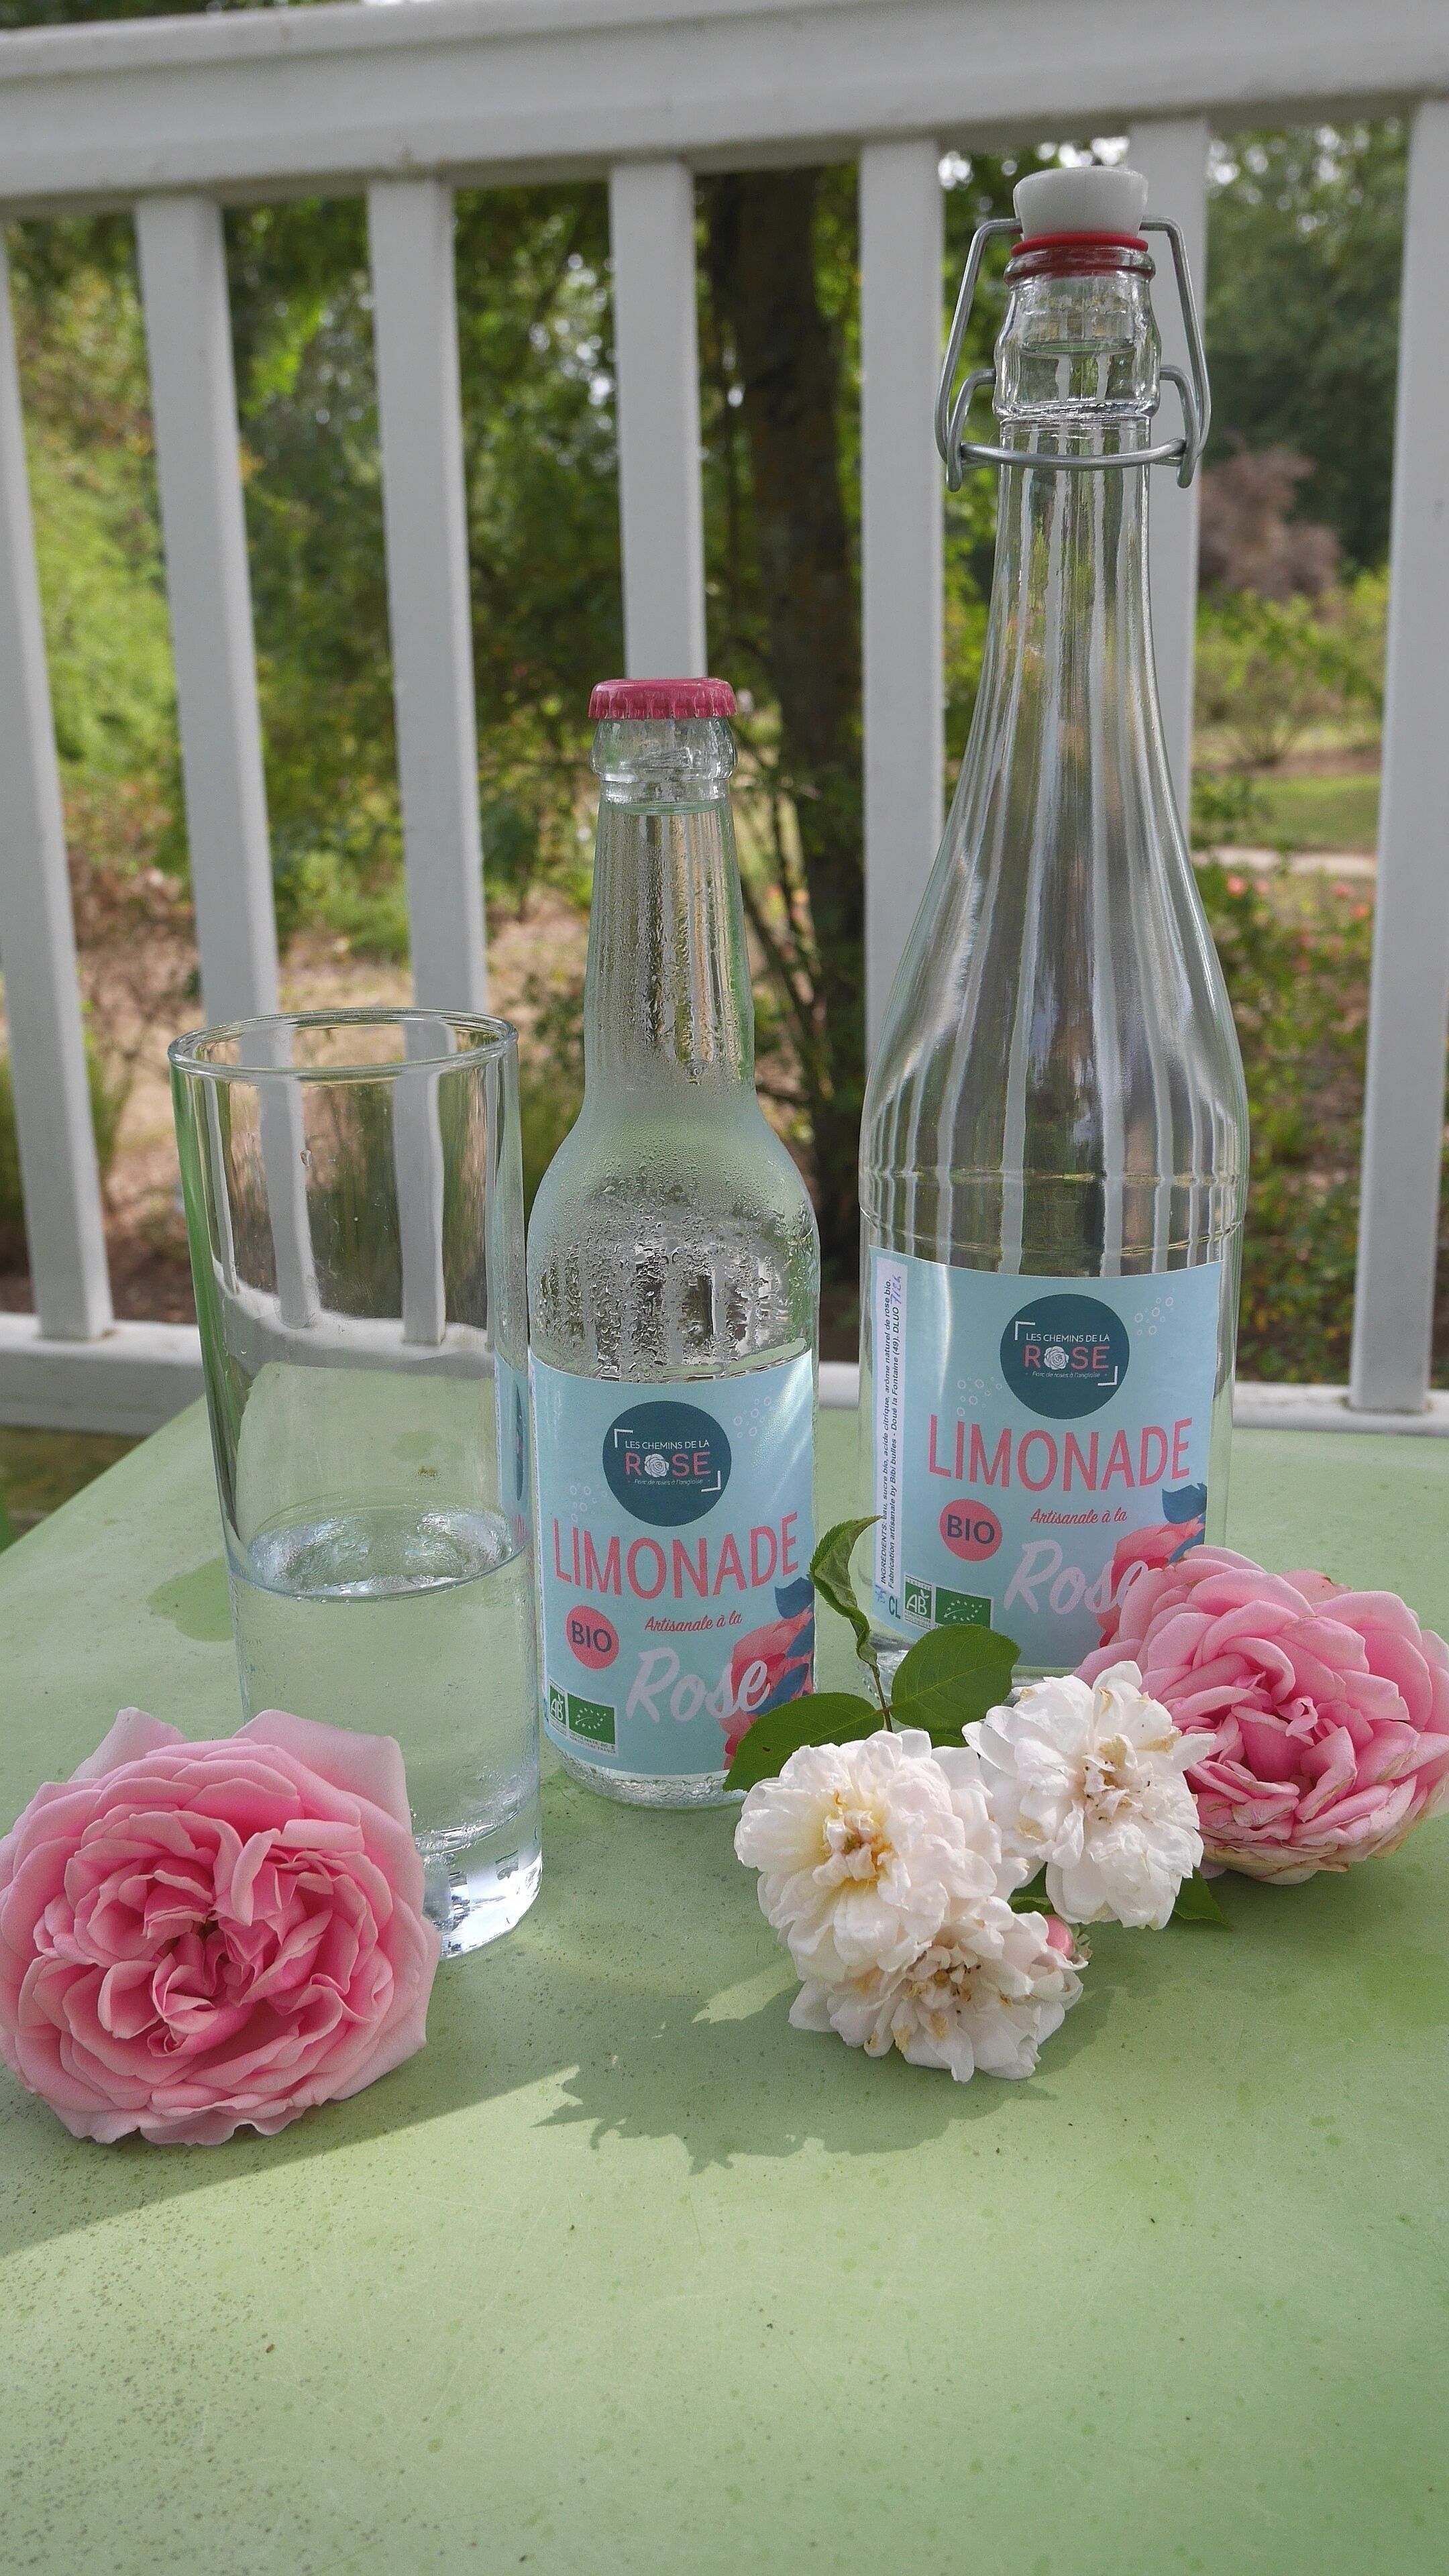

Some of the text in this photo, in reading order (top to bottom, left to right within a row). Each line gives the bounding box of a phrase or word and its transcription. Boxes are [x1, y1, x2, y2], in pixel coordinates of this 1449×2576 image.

[884, 1319, 890, 1330] de
[892, 1336, 900, 1355] (49).
[1026, 1333, 1110, 1342] LES CHEMINS DE LA
[892, 1397, 898, 1406] la
[625, 1439, 710, 1450] LES CHEMINS DE LA
[928, 1414, 1193, 1493] LIMONADE
[890, 1485, 897, 1497] by
[888, 1498, 896, 1540] artisanale
[1030, 1507, 1128, 1525] Artisanale à la
[947, 1513, 996, 1544] BIO
[552, 1511, 799, 1601] LIMONADE
[888, 1595, 901, 1619] CL
[906, 1593, 928, 1615] AB
[643, 1610, 743, 1633] Artisanale à la
[571, 1620, 612, 1653] BIO
[623, 1646, 771, 1723] Rose
[550, 1698, 564, 1721] AB
